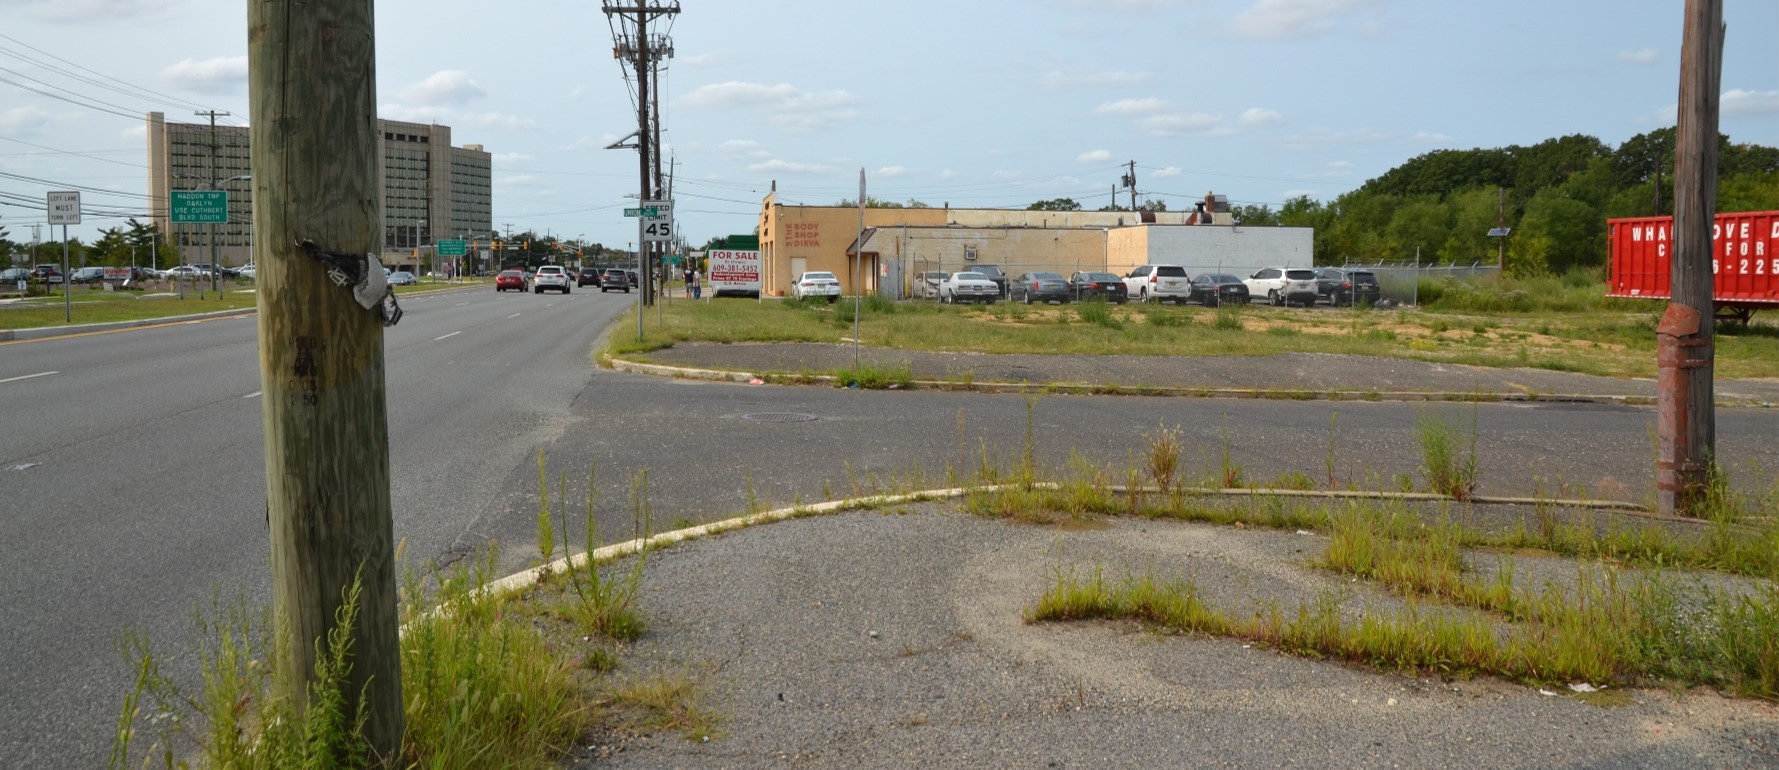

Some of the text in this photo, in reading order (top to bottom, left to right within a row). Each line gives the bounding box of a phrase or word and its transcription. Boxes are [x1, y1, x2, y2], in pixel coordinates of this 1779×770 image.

[624, 209, 640, 217] UNION
[645, 223, 670, 236] 45
[785, 223, 793, 240] THE
[793, 231, 819, 239] SHOP
[1632, 226, 1674, 241] WHA
[713, 251, 732, 259] FOR
[1725, 241, 1765, 256] FOR
